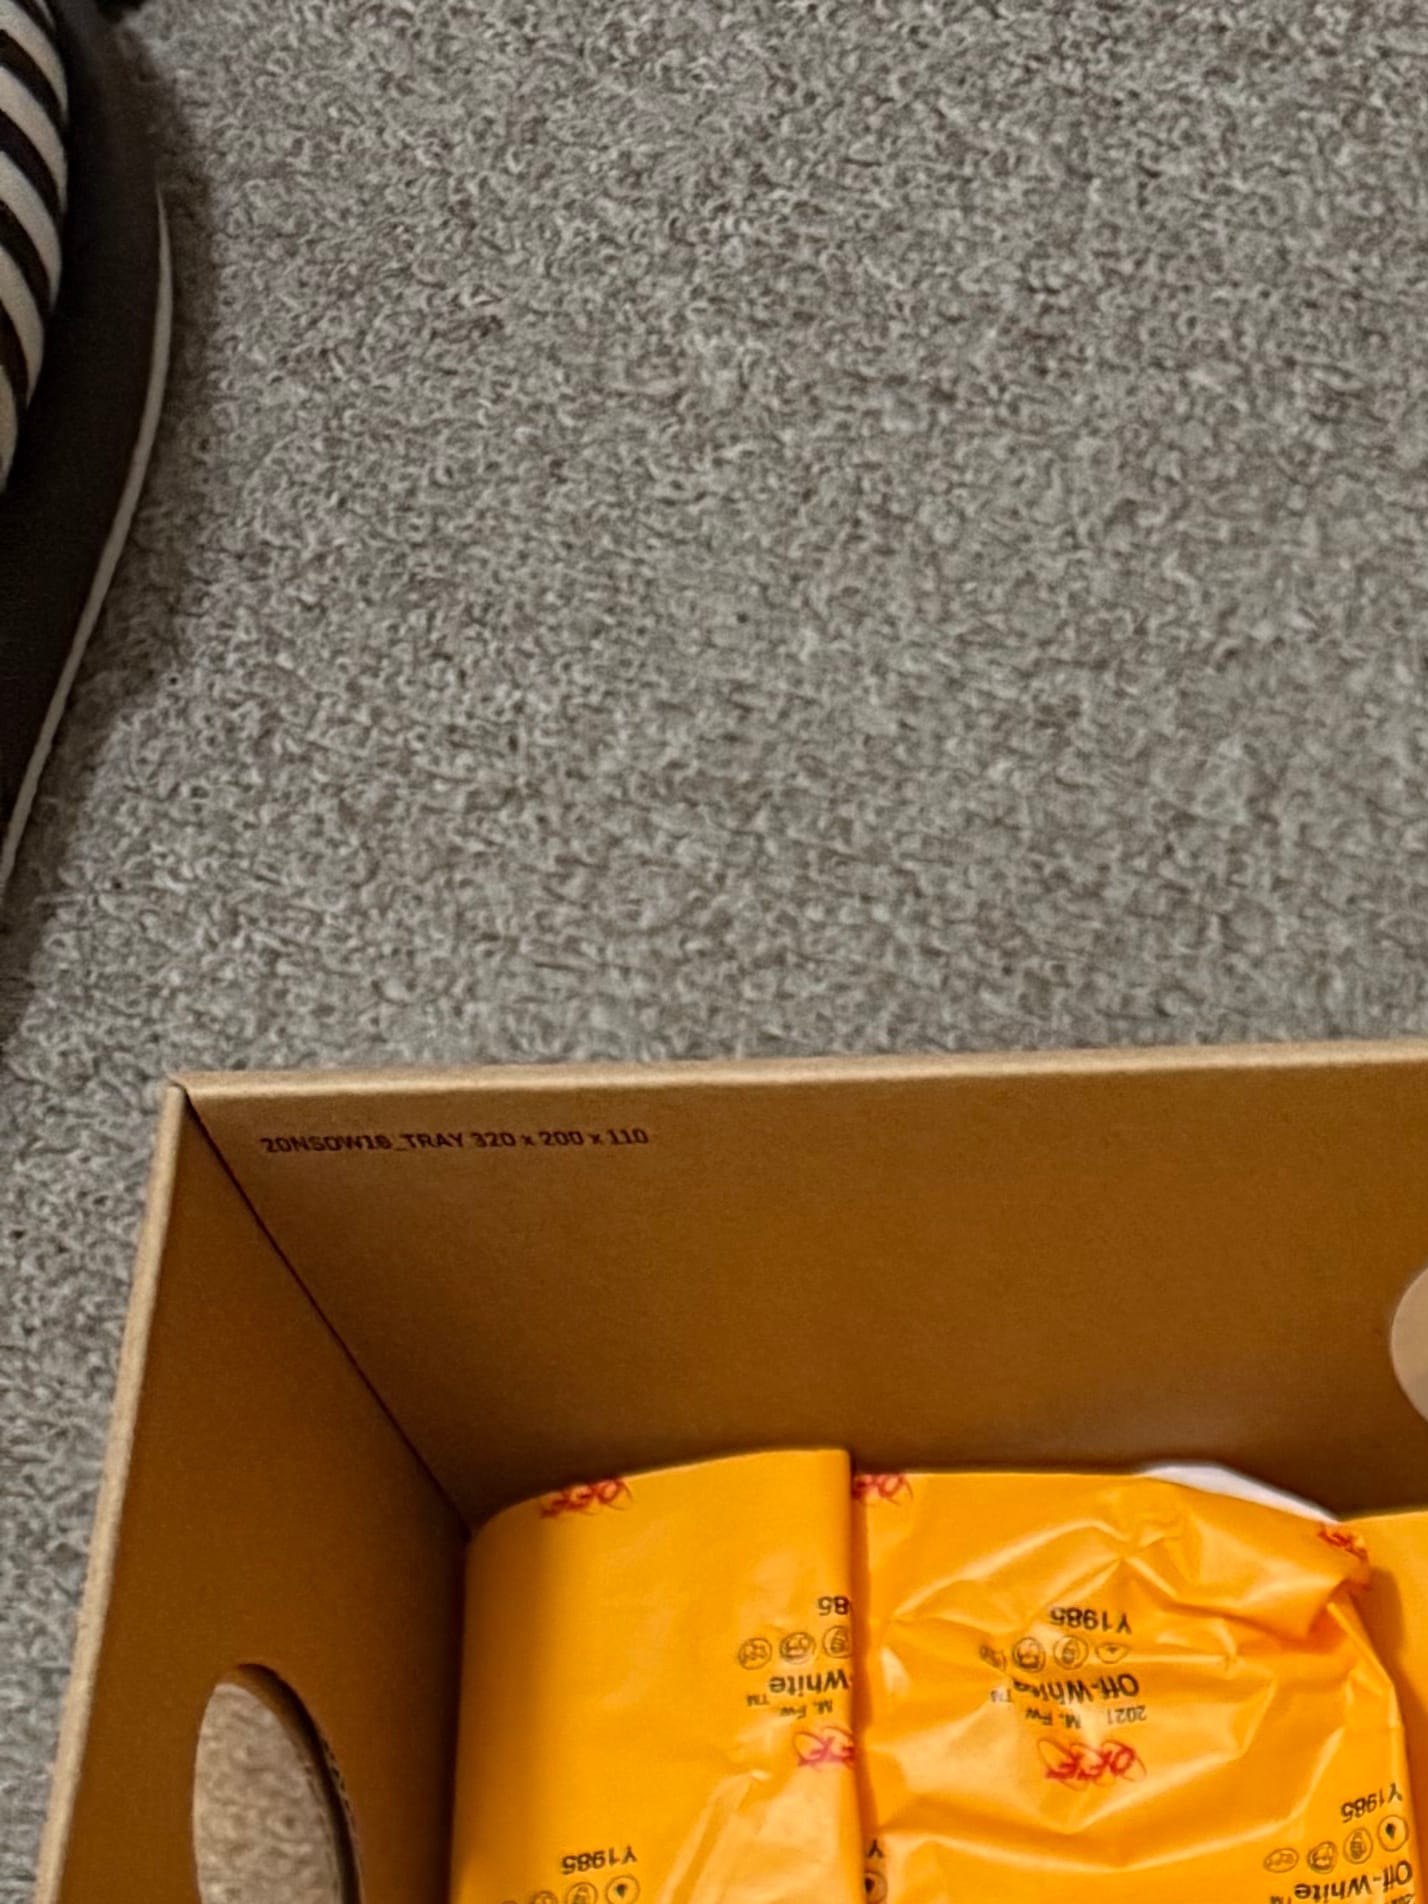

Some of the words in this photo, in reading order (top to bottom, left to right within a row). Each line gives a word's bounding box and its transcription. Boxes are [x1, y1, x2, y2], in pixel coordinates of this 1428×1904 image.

[472, 1132, 515, 1149] 320
[541, 1130, 584, 1147] 200
[610, 1128, 649, 1146] 110
[1050, 1607, 1132, 1635] Y1985
[1341, 1782, 1404, 1823] Y1985
[560, 1845, 639, 1876] Y1985
[1293, 1860, 1412, 1901] Off-White
